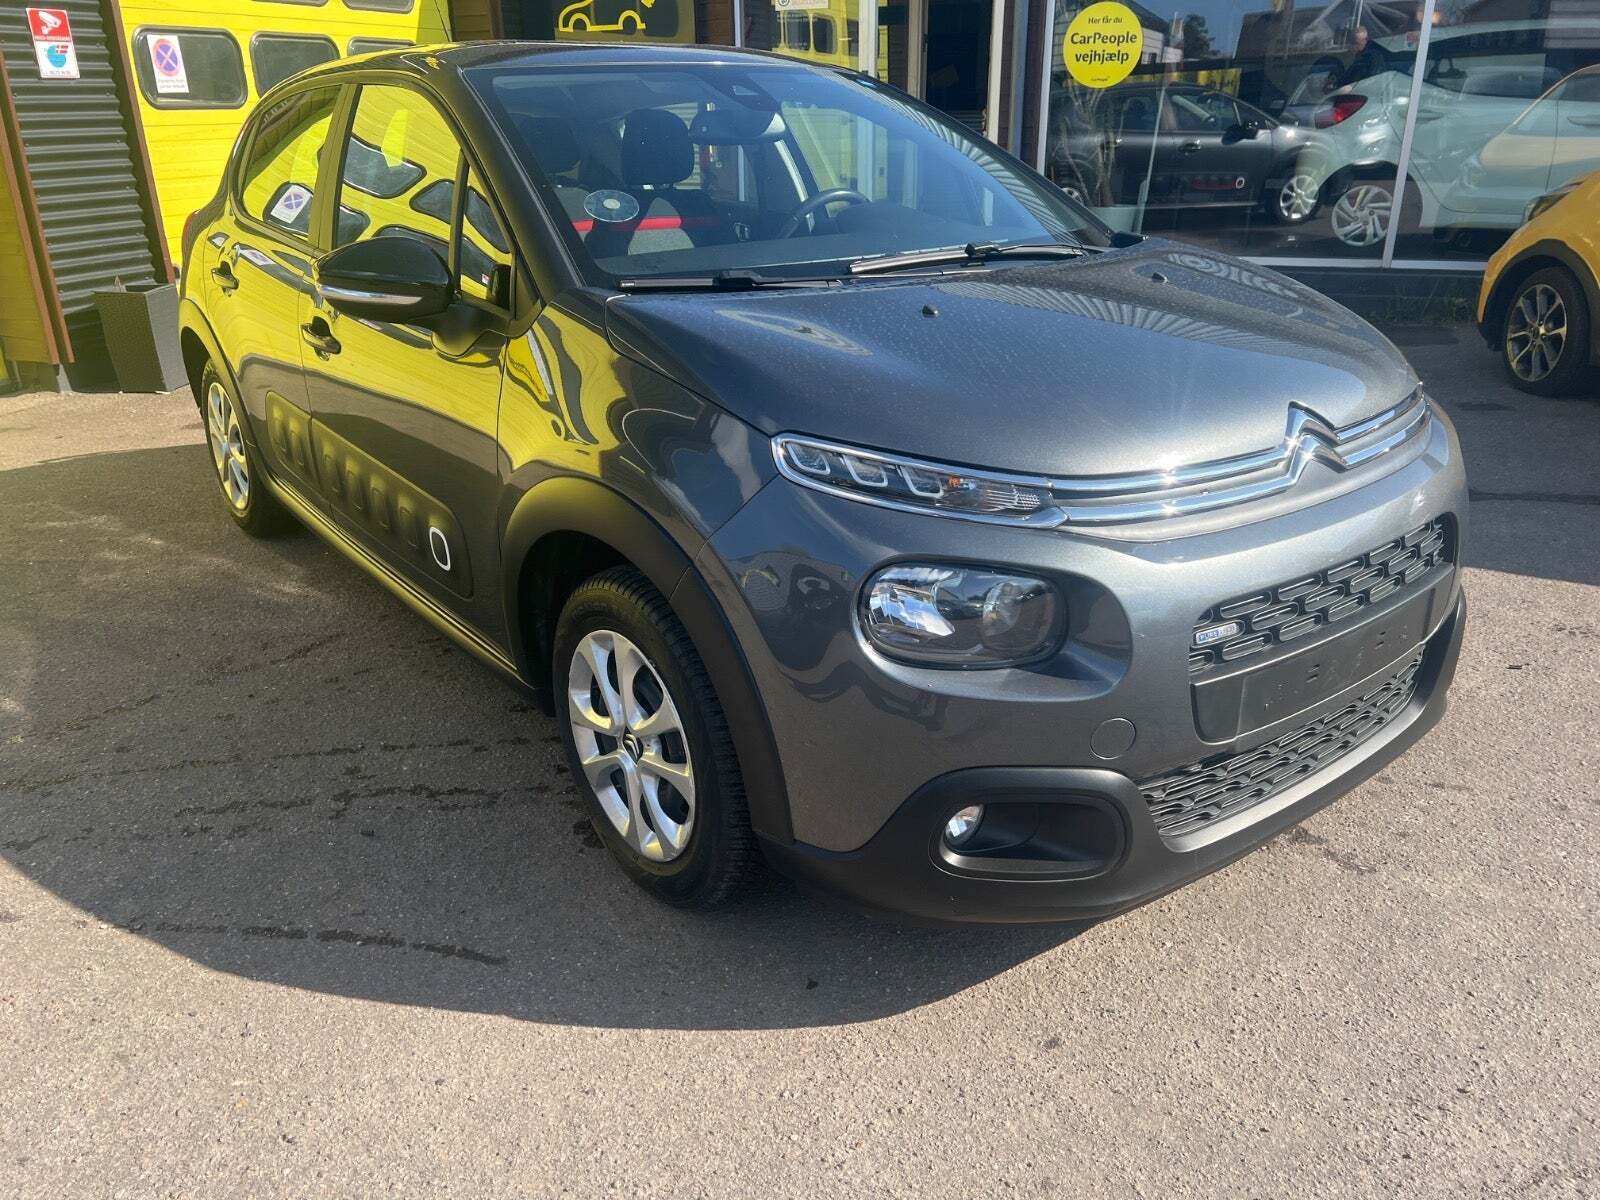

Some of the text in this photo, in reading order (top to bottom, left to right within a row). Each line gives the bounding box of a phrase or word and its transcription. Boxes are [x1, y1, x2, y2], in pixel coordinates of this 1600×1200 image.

[1102, 15, 1112, 24] får
[1113, 16, 1123, 24] du
[1070, 31, 1137, 46] CarPeople
[1075, 49, 1129, 65] vejhjælp
